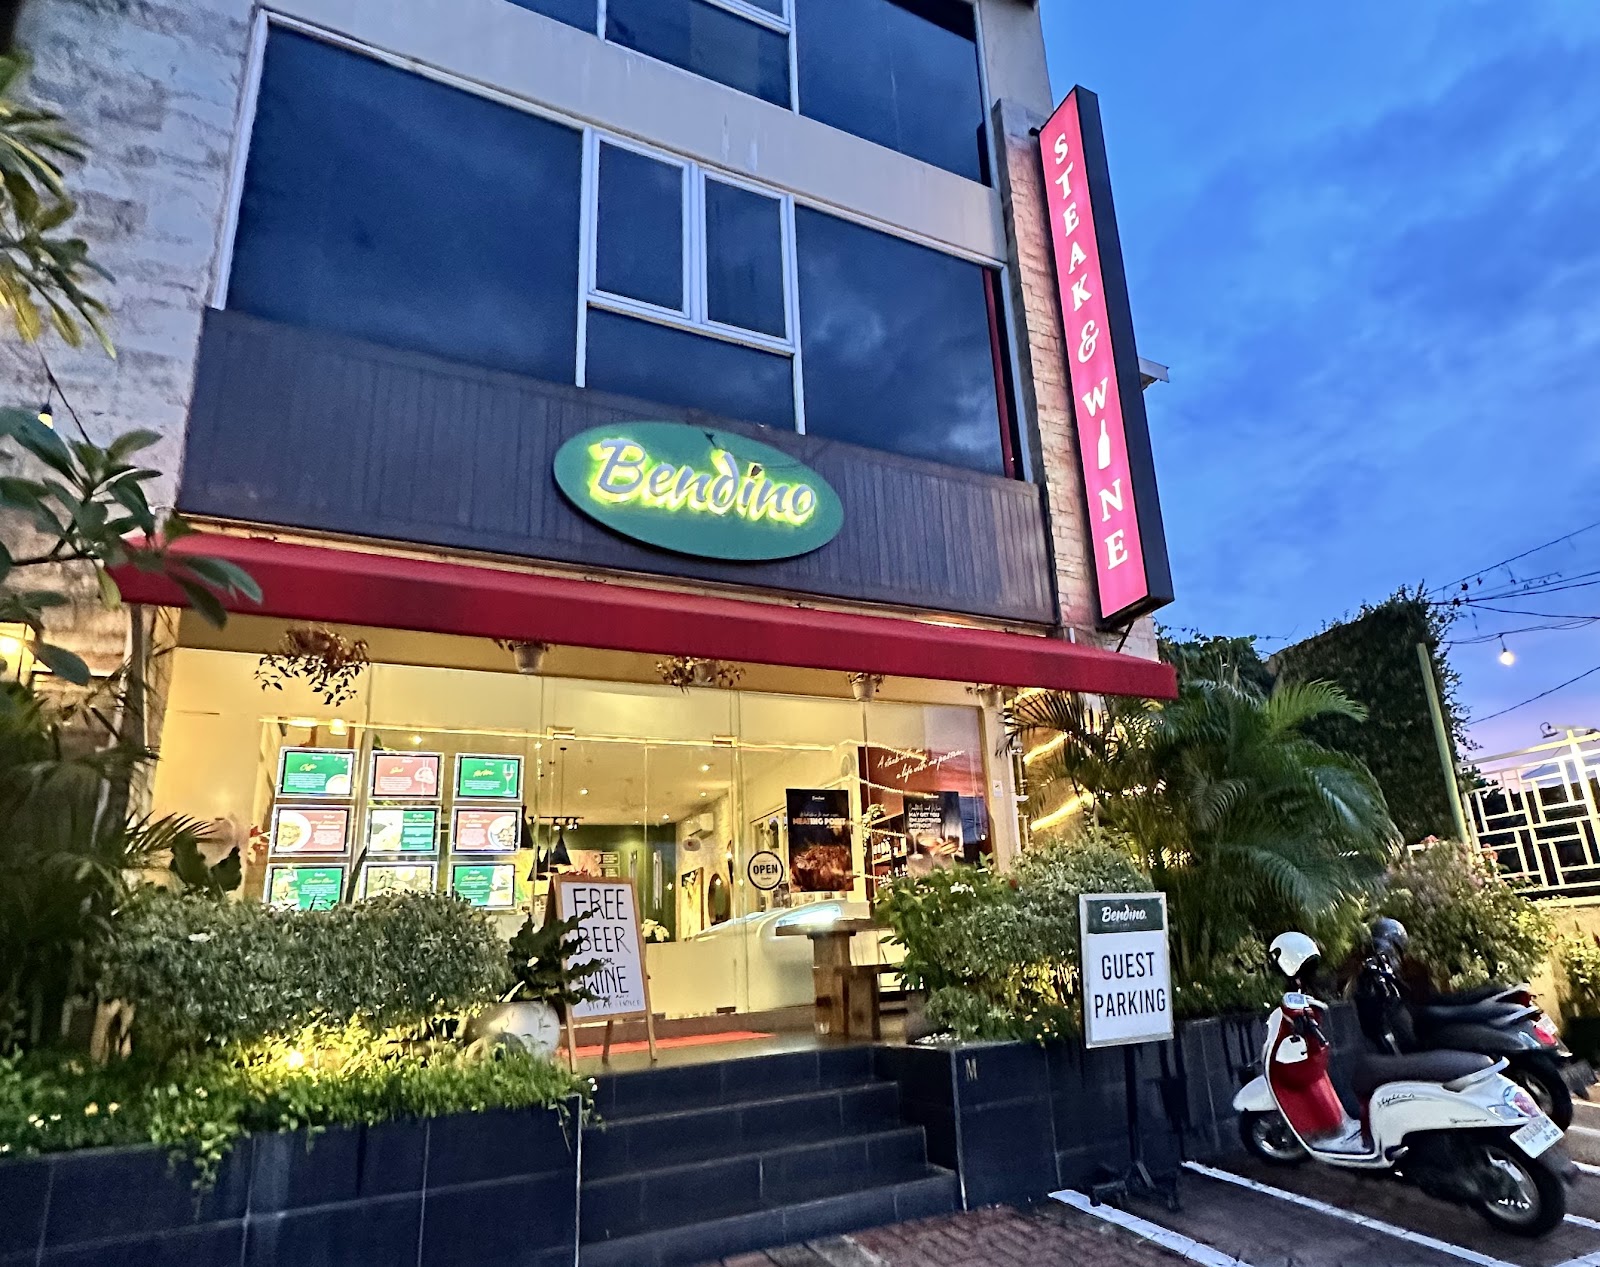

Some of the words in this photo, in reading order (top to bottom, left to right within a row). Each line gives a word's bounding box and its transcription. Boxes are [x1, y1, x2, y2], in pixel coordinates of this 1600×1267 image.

[1053, 132, 1093, 312] STEAK
[1077, 319, 1100, 364] &
[593, 437, 817, 520] Bendino
[753, 863, 778, 875] OPEN
[573, 888, 628, 920] FREE
[577, 926, 632, 954] BEER
[582, 966, 629, 995] WINE
[1101, 951, 1155, 981] GUEST
[1094, 987, 1167, 1019] PARKING
